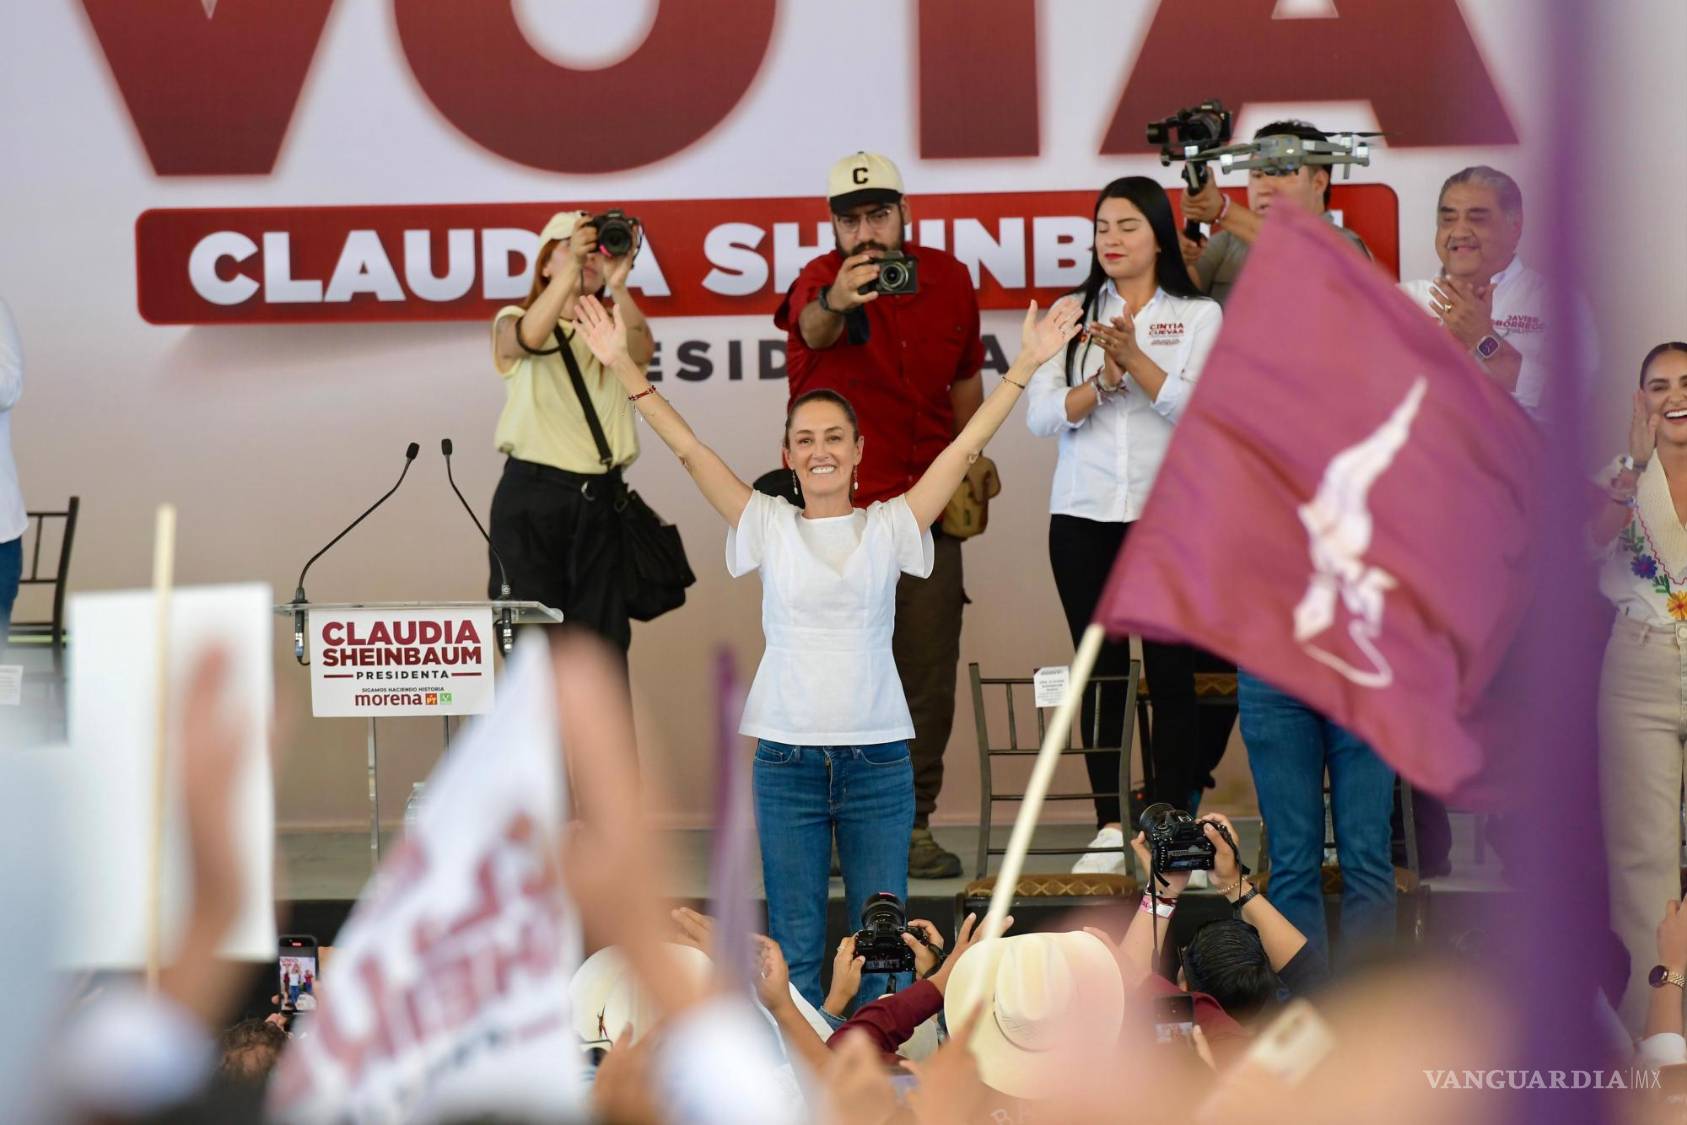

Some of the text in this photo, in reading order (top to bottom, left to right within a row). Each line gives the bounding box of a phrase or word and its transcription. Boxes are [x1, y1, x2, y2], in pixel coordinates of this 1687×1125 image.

[852, 167, 869, 185] C
[188, 229, 672, 306] CLAUDA
[1149, 322, 1184, 330] CINTIA
[322, 620, 481, 646] CLAUDIA
[322, 647, 482, 667] SHEINBAUM
[356, 670, 449, 680] PRESIDENTA
[355, 693, 423, 706] morena
